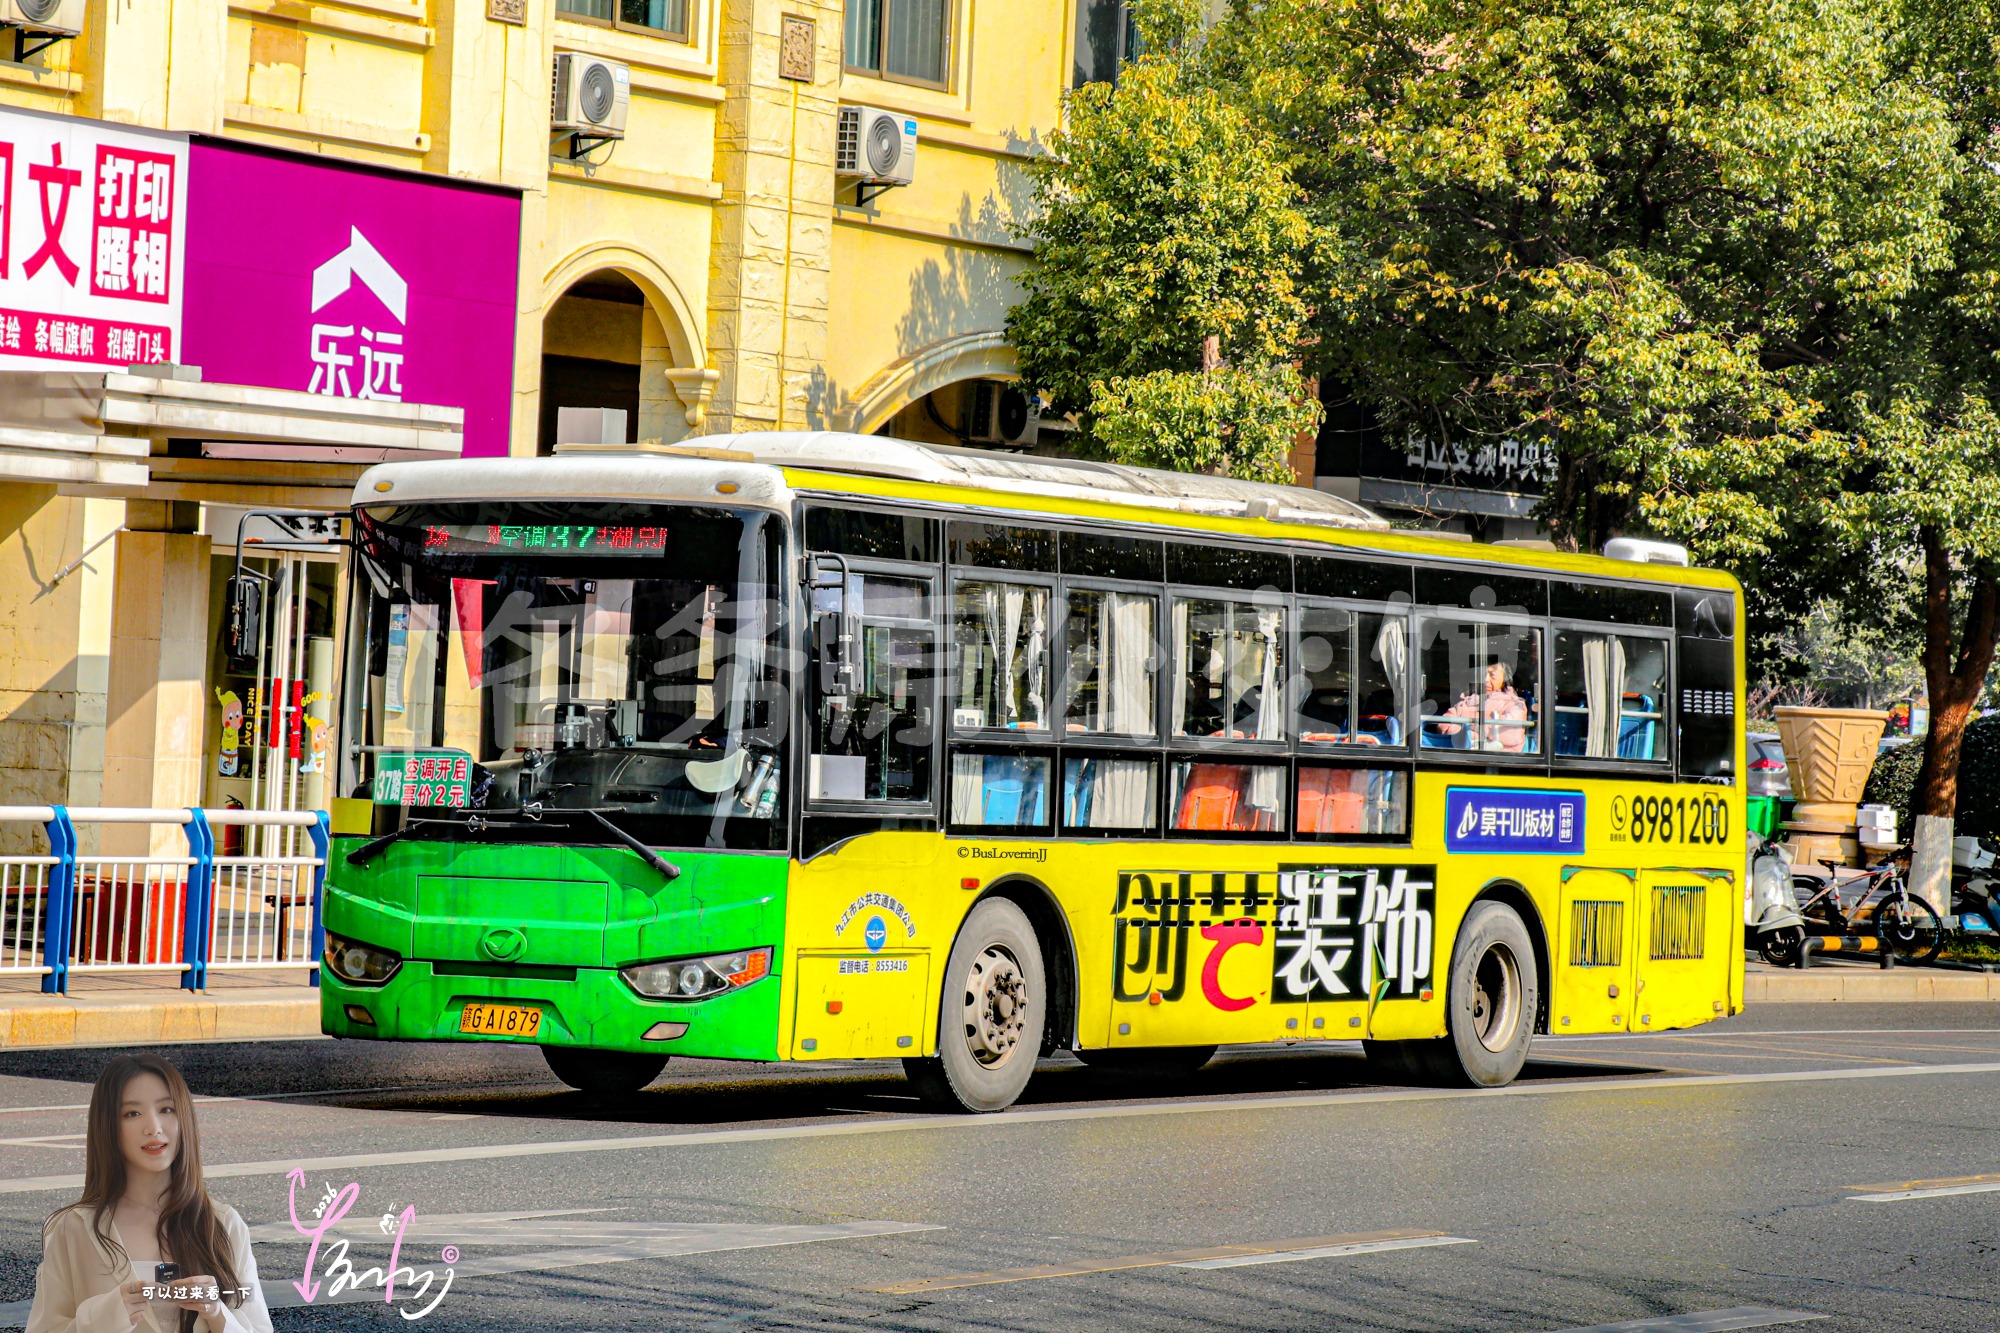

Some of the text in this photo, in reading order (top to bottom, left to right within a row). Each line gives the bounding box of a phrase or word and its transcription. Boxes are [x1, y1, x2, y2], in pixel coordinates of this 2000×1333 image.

[99, 154, 170, 224] 打印
[95, 226, 167, 296] 照相
[34, 318, 95, 357] 条幅旗帜
[107, 326, 165, 364] 招牌门头
[308, 322, 404, 403] 乐远
[244, 687, 255, 747] NICE DAY
[404, 757, 468, 781] 空调开启
[401, 784, 466, 808] 票价2元
[1631, 795, 1729, 845] 8981200
[1481, 807, 1555, 838] 莫干山板材
[834, 891, 917, 938] 九江市公共交通集团公司
